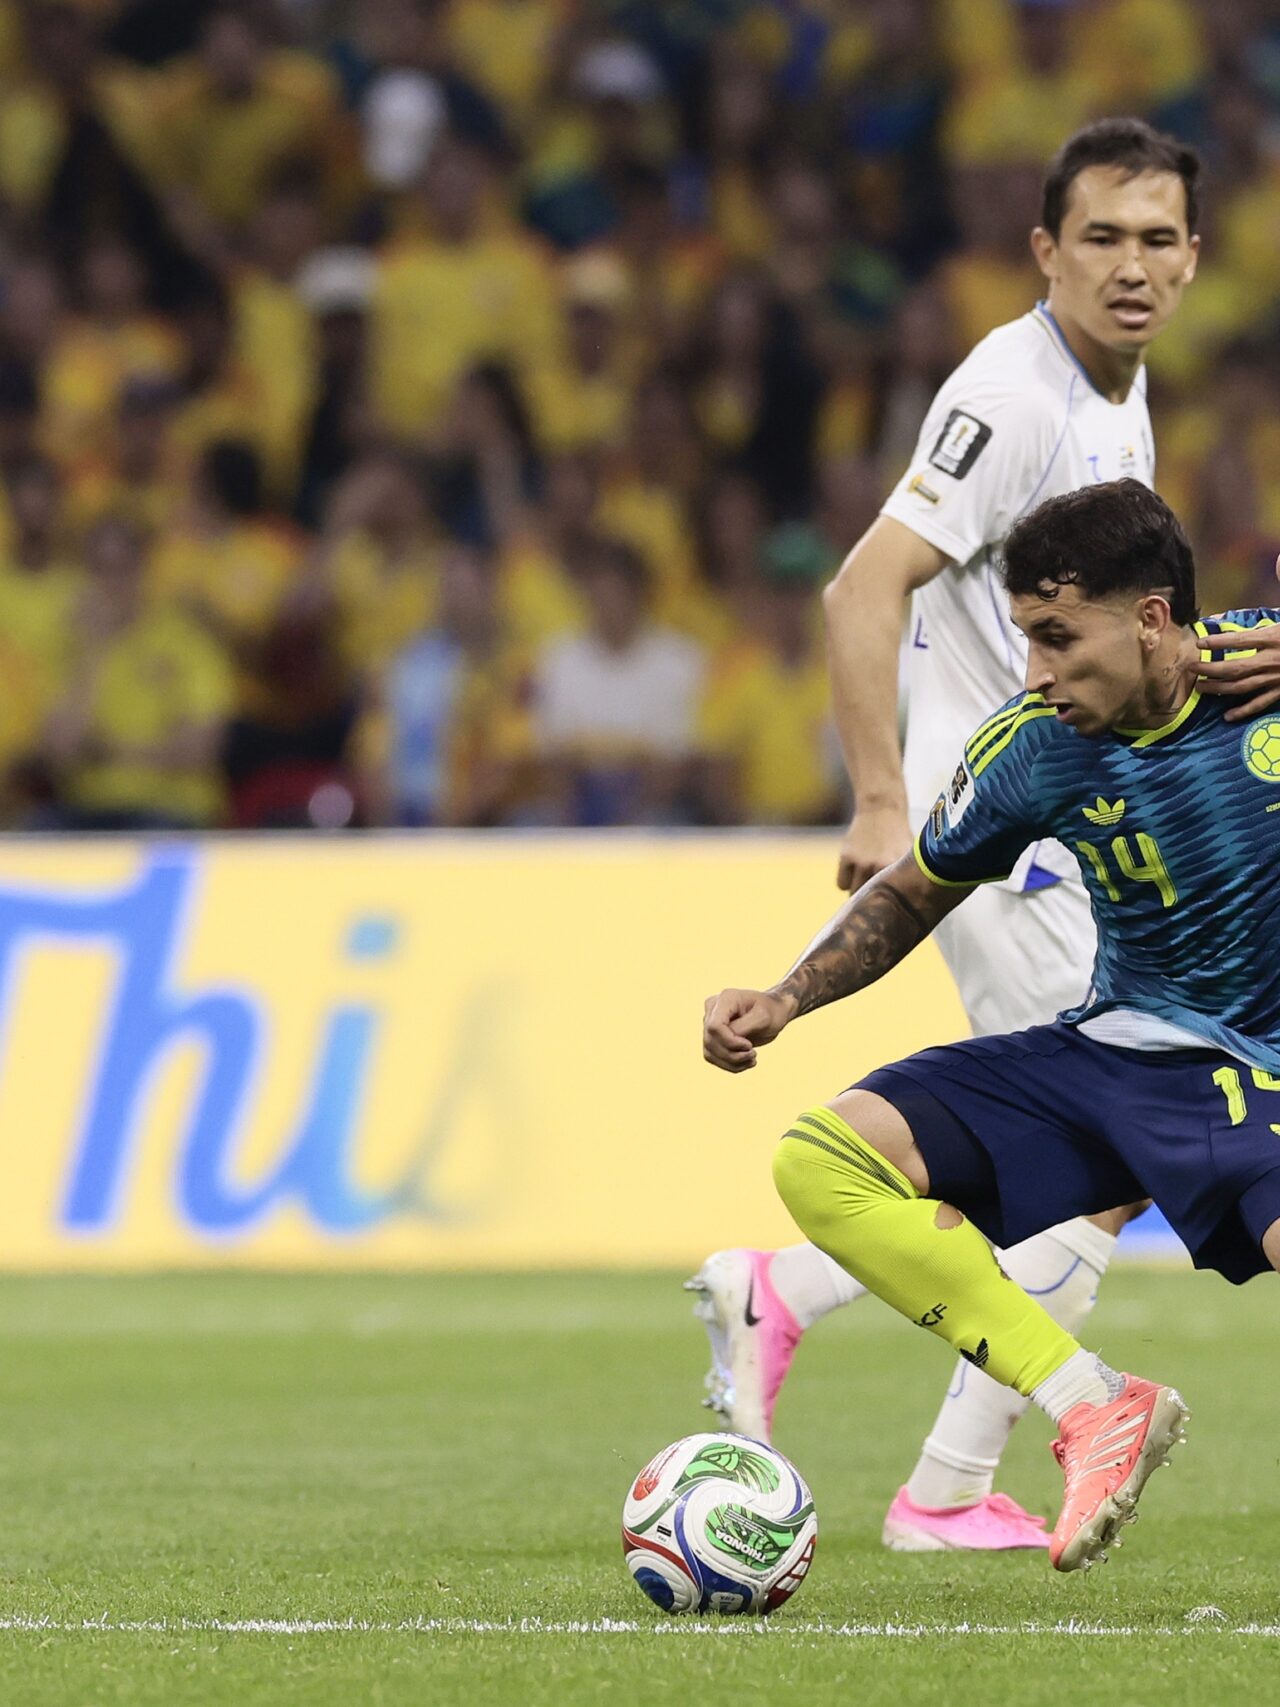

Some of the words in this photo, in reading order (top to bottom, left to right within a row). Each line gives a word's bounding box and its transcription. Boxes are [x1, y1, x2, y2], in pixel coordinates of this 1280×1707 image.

[1075, 832, 1178, 908] 14
[912, 1303, 948, 1328] CF
[715, 1528, 767, 1564] TRIONDA
